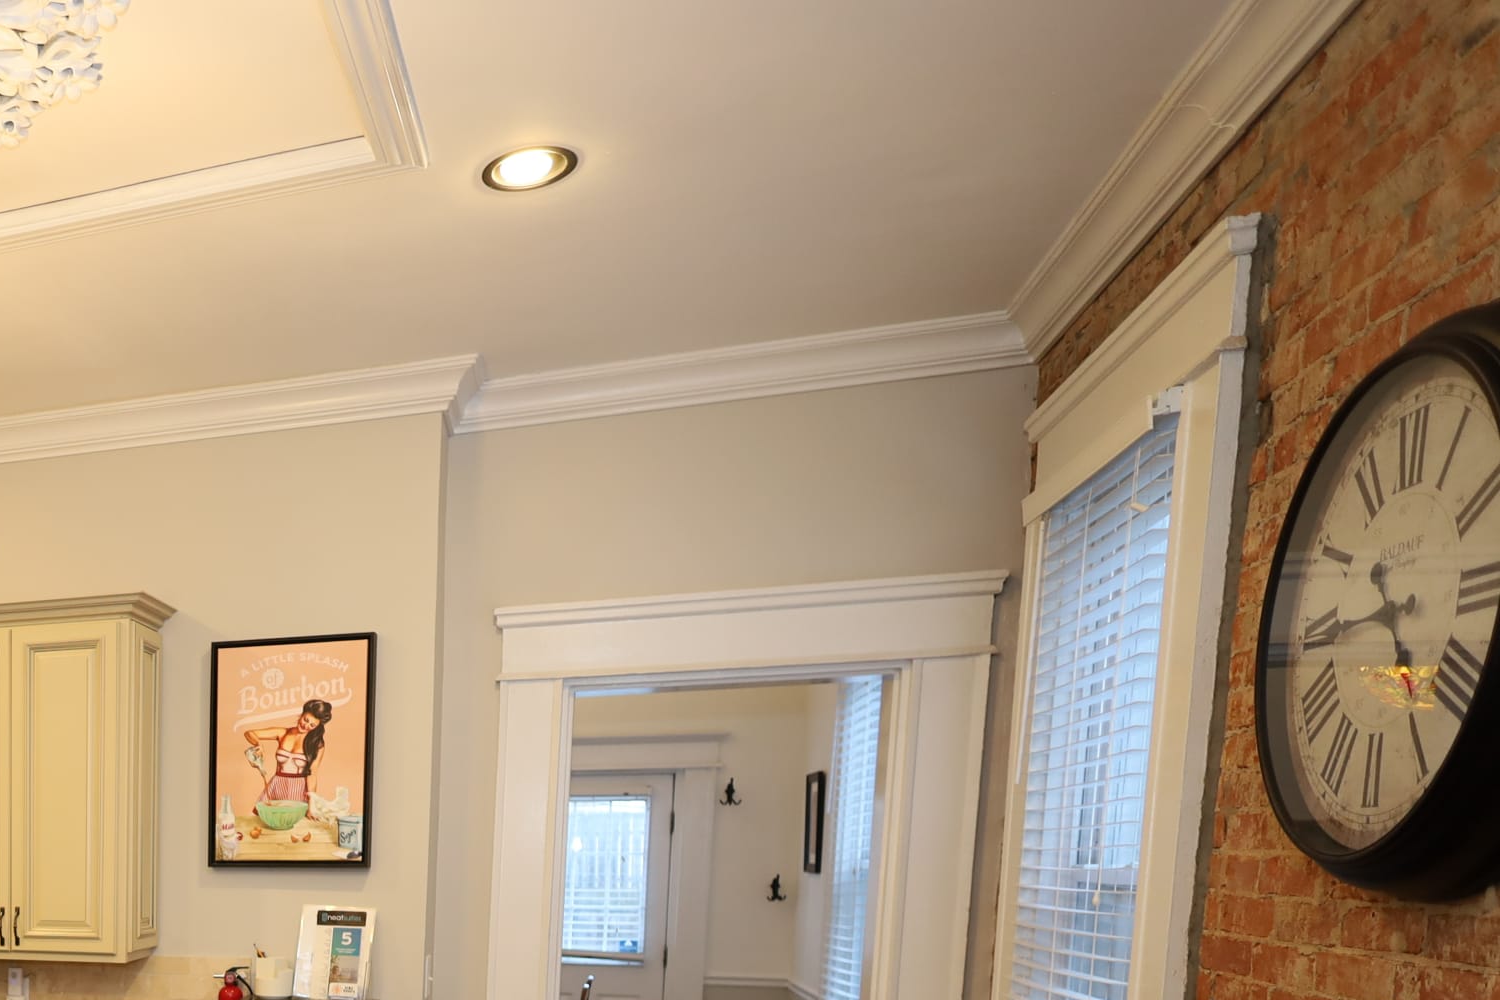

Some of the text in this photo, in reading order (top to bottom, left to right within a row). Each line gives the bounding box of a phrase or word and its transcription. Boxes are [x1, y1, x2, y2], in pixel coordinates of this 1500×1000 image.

[1391, 402, 1431, 495] XII
[251, 653, 294, 672] LITTLE
[300, 652, 348, 672] SPLASH
[237, 675, 346, 714] Bourbon
[341, 931, 352, 945] 5
